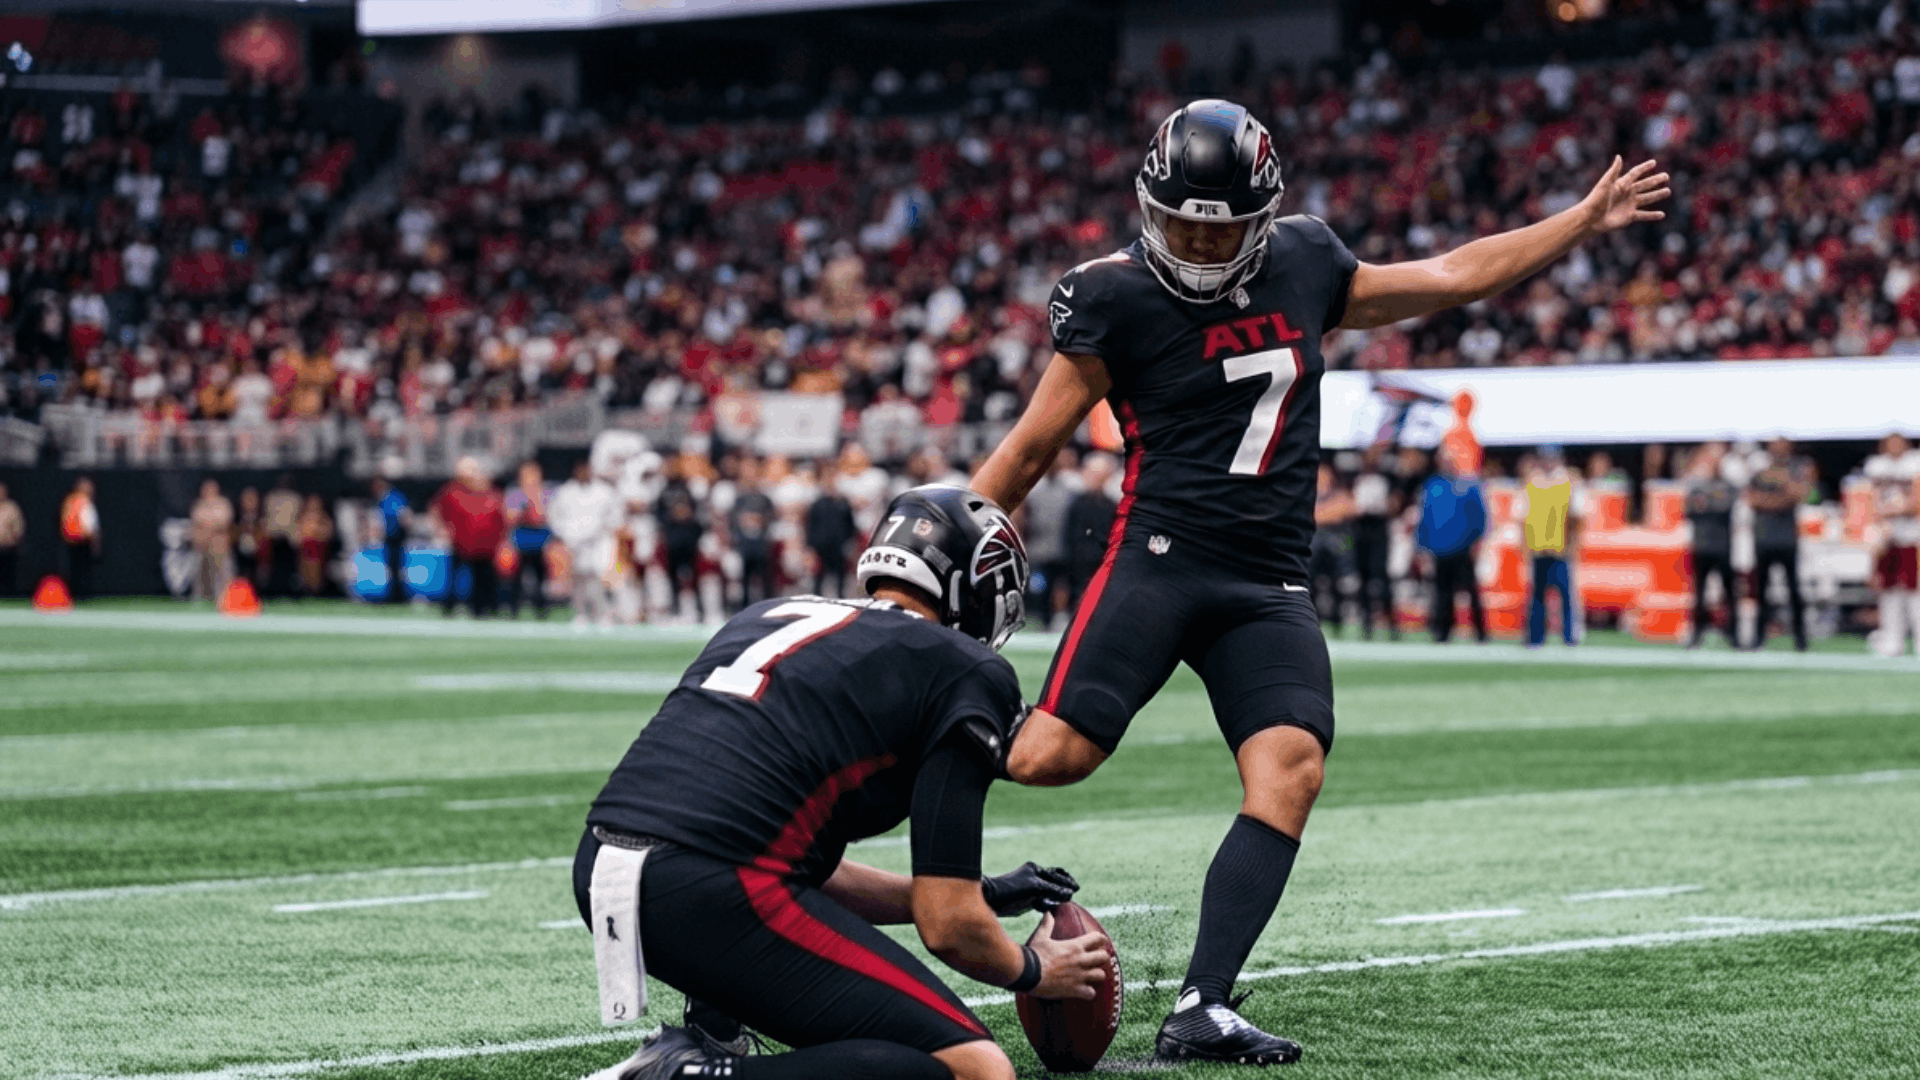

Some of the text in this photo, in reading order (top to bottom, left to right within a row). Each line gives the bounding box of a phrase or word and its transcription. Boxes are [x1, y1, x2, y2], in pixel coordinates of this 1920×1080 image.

[1202, 313, 1304, 360] ATL
[1222, 347, 1306, 475] 7
[884, 515, 906, 543] 7
[700, 600, 862, 702] 7
